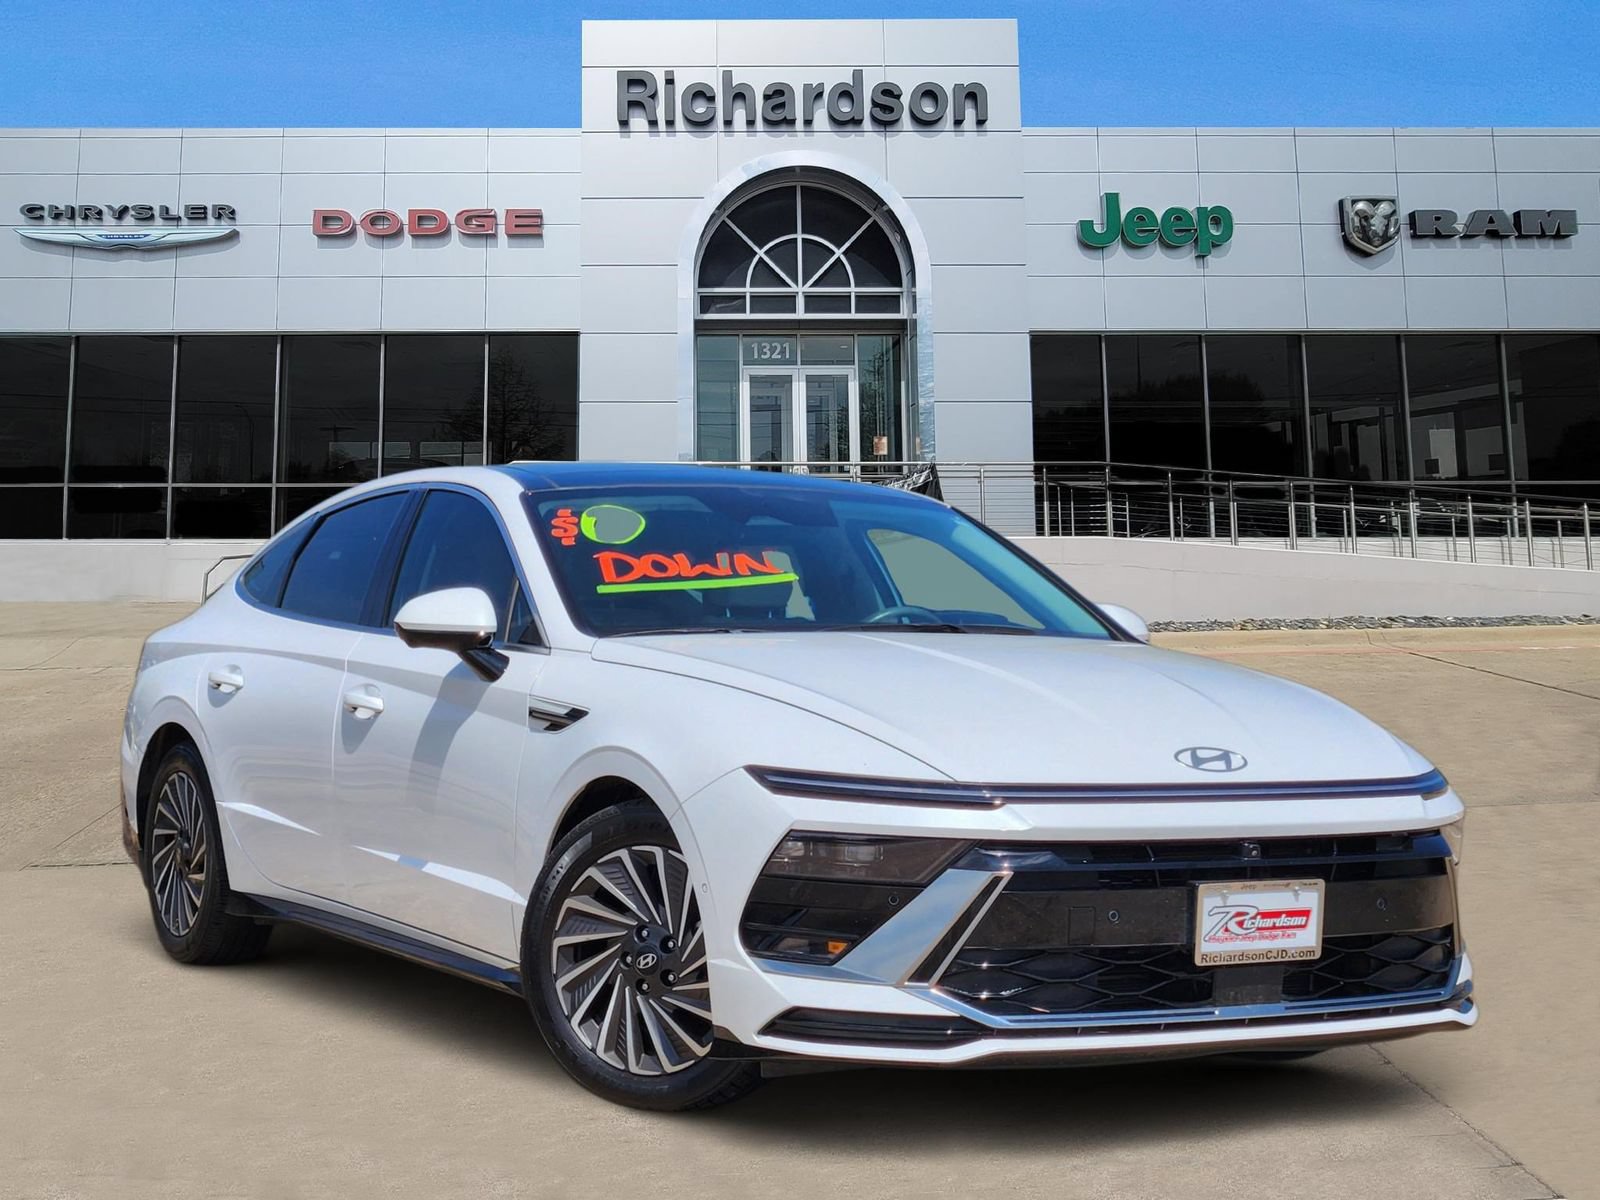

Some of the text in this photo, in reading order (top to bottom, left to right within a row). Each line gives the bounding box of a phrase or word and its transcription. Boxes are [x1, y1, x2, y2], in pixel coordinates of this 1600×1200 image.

[616, 69, 989, 126] Richardson
[19, 203, 237, 219] CHRYSLER
[312, 208, 544, 236] DODGE
[1078, 192, 1234, 258] Jeep
[1408, 209, 1578, 239] RAM
[751, 342, 790, 359] 1321
[593, 551, 785, 584] DOWN
[1203, 904, 1308, 942] Richardson
[1201, 949, 1316, 964] RichardsonCJD.com
